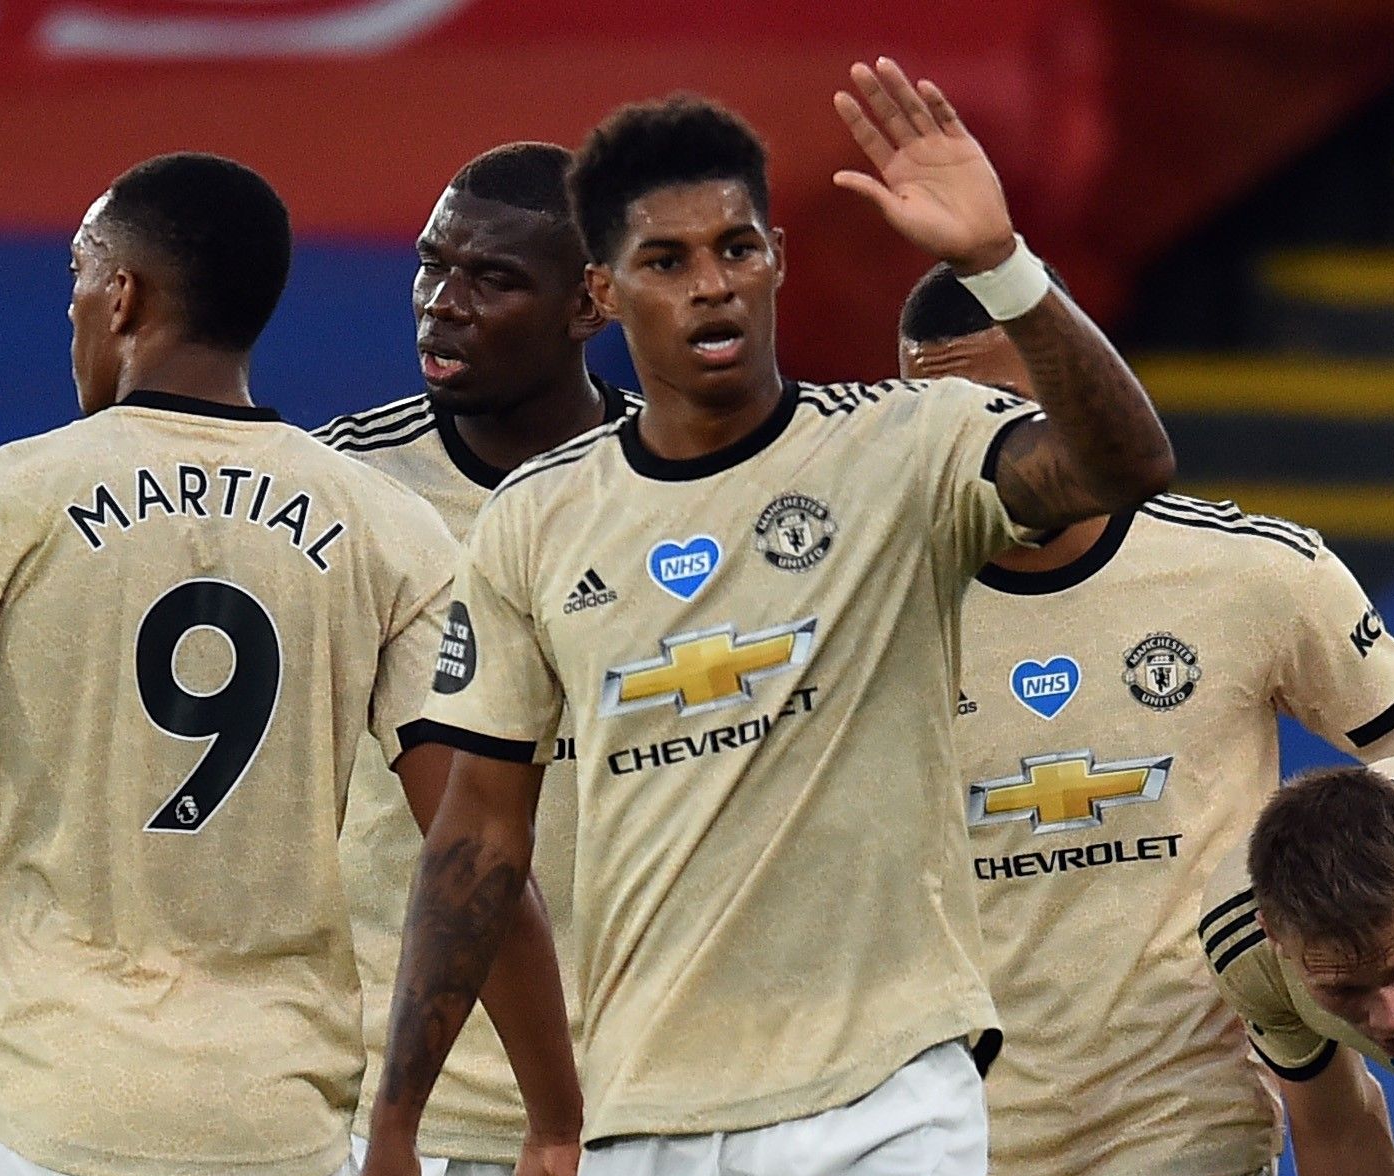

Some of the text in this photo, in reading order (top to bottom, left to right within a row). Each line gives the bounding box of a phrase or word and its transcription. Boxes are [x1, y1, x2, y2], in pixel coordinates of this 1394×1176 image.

[65, 463, 346, 573] MARTIAL
[664, 554, 706, 577] NHS
[563, 589, 618, 615] adidas
[1129, 638, 1194, 664] MANCHESTER
[1025, 674, 1066, 695] NHS
[134, 577, 284, 835] 9
[1141, 691, 1186, 706] UNITED
[973, 833, 1184, 881] CHEVROLET
